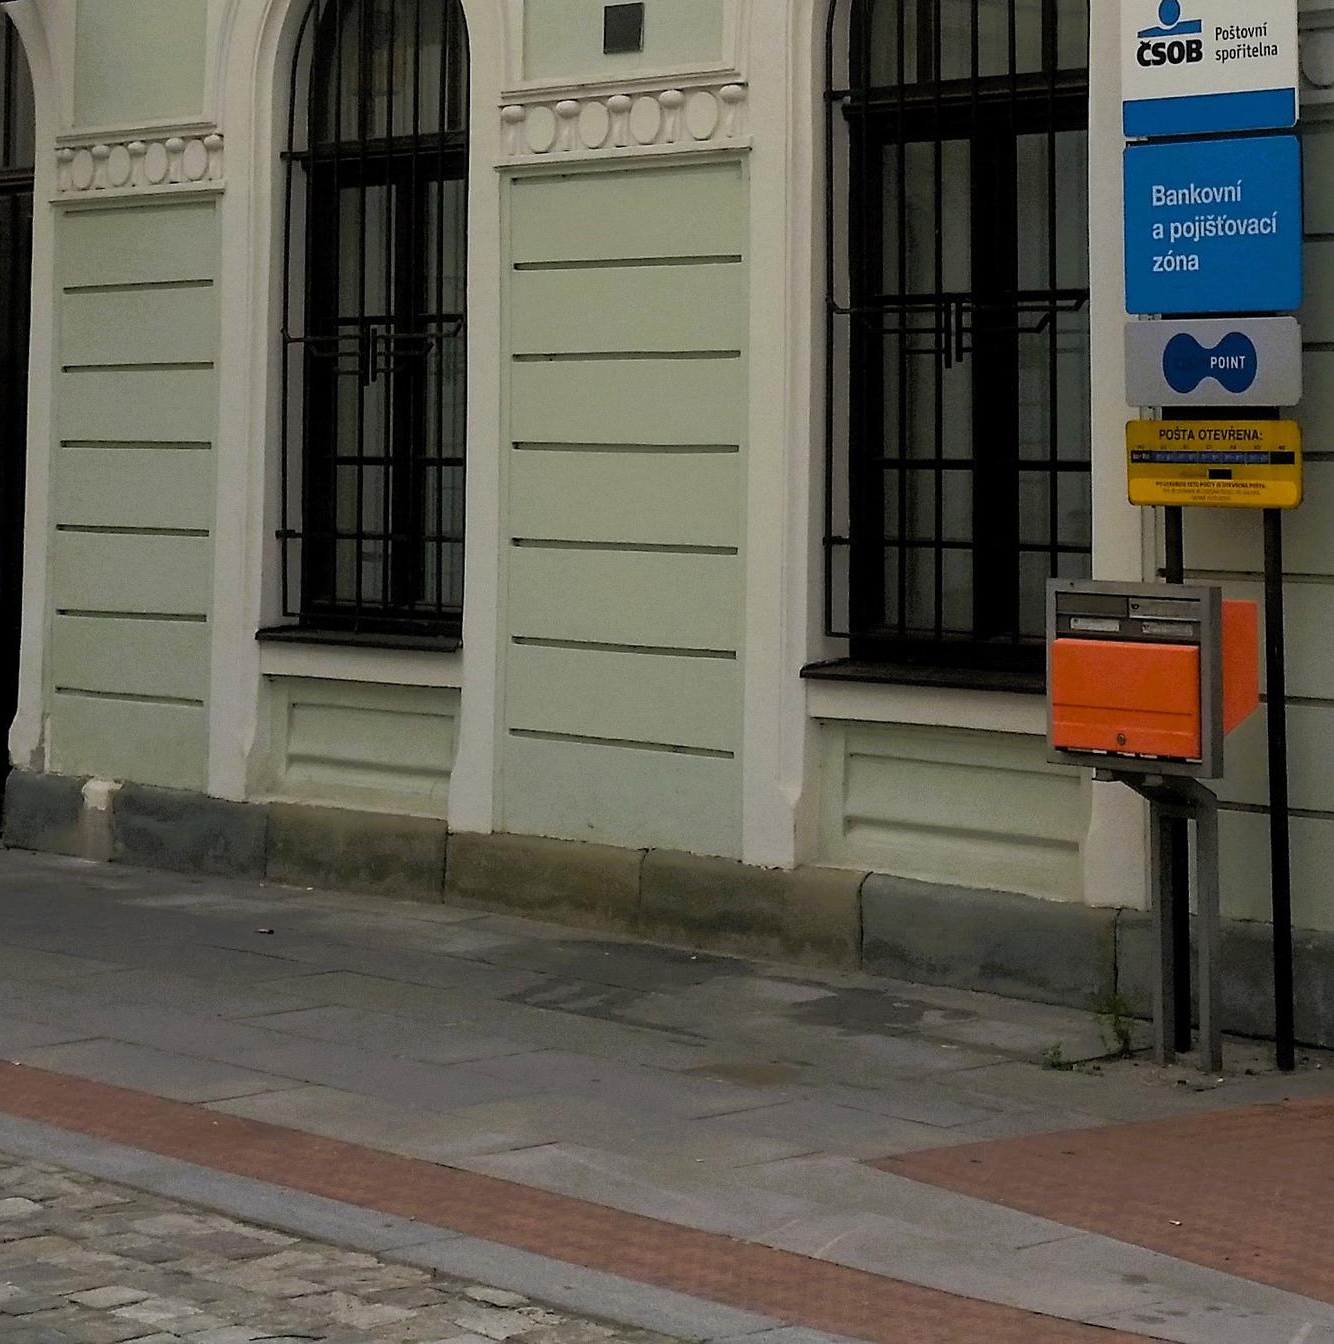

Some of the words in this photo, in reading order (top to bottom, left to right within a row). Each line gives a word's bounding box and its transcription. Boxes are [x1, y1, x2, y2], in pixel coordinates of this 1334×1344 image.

[1215, 22, 1268, 41] Poštovní
[1136, 39, 1204, 67] ČSOB
[1215, 42, 1278, 64] spořitelna
[1151, 179, 1243, 207] Bankovní
[1152, 222, 1164, 240] a
[1170, 211, 1278, 243] pojišťovací
[1152, 250, 1200, 272] zóna
[1210, 355, 1246, 369] POINT
[1159, 425, 1195, 441] POŠTA
[1198, 425, 1264, 441] OTEVŘENA:
